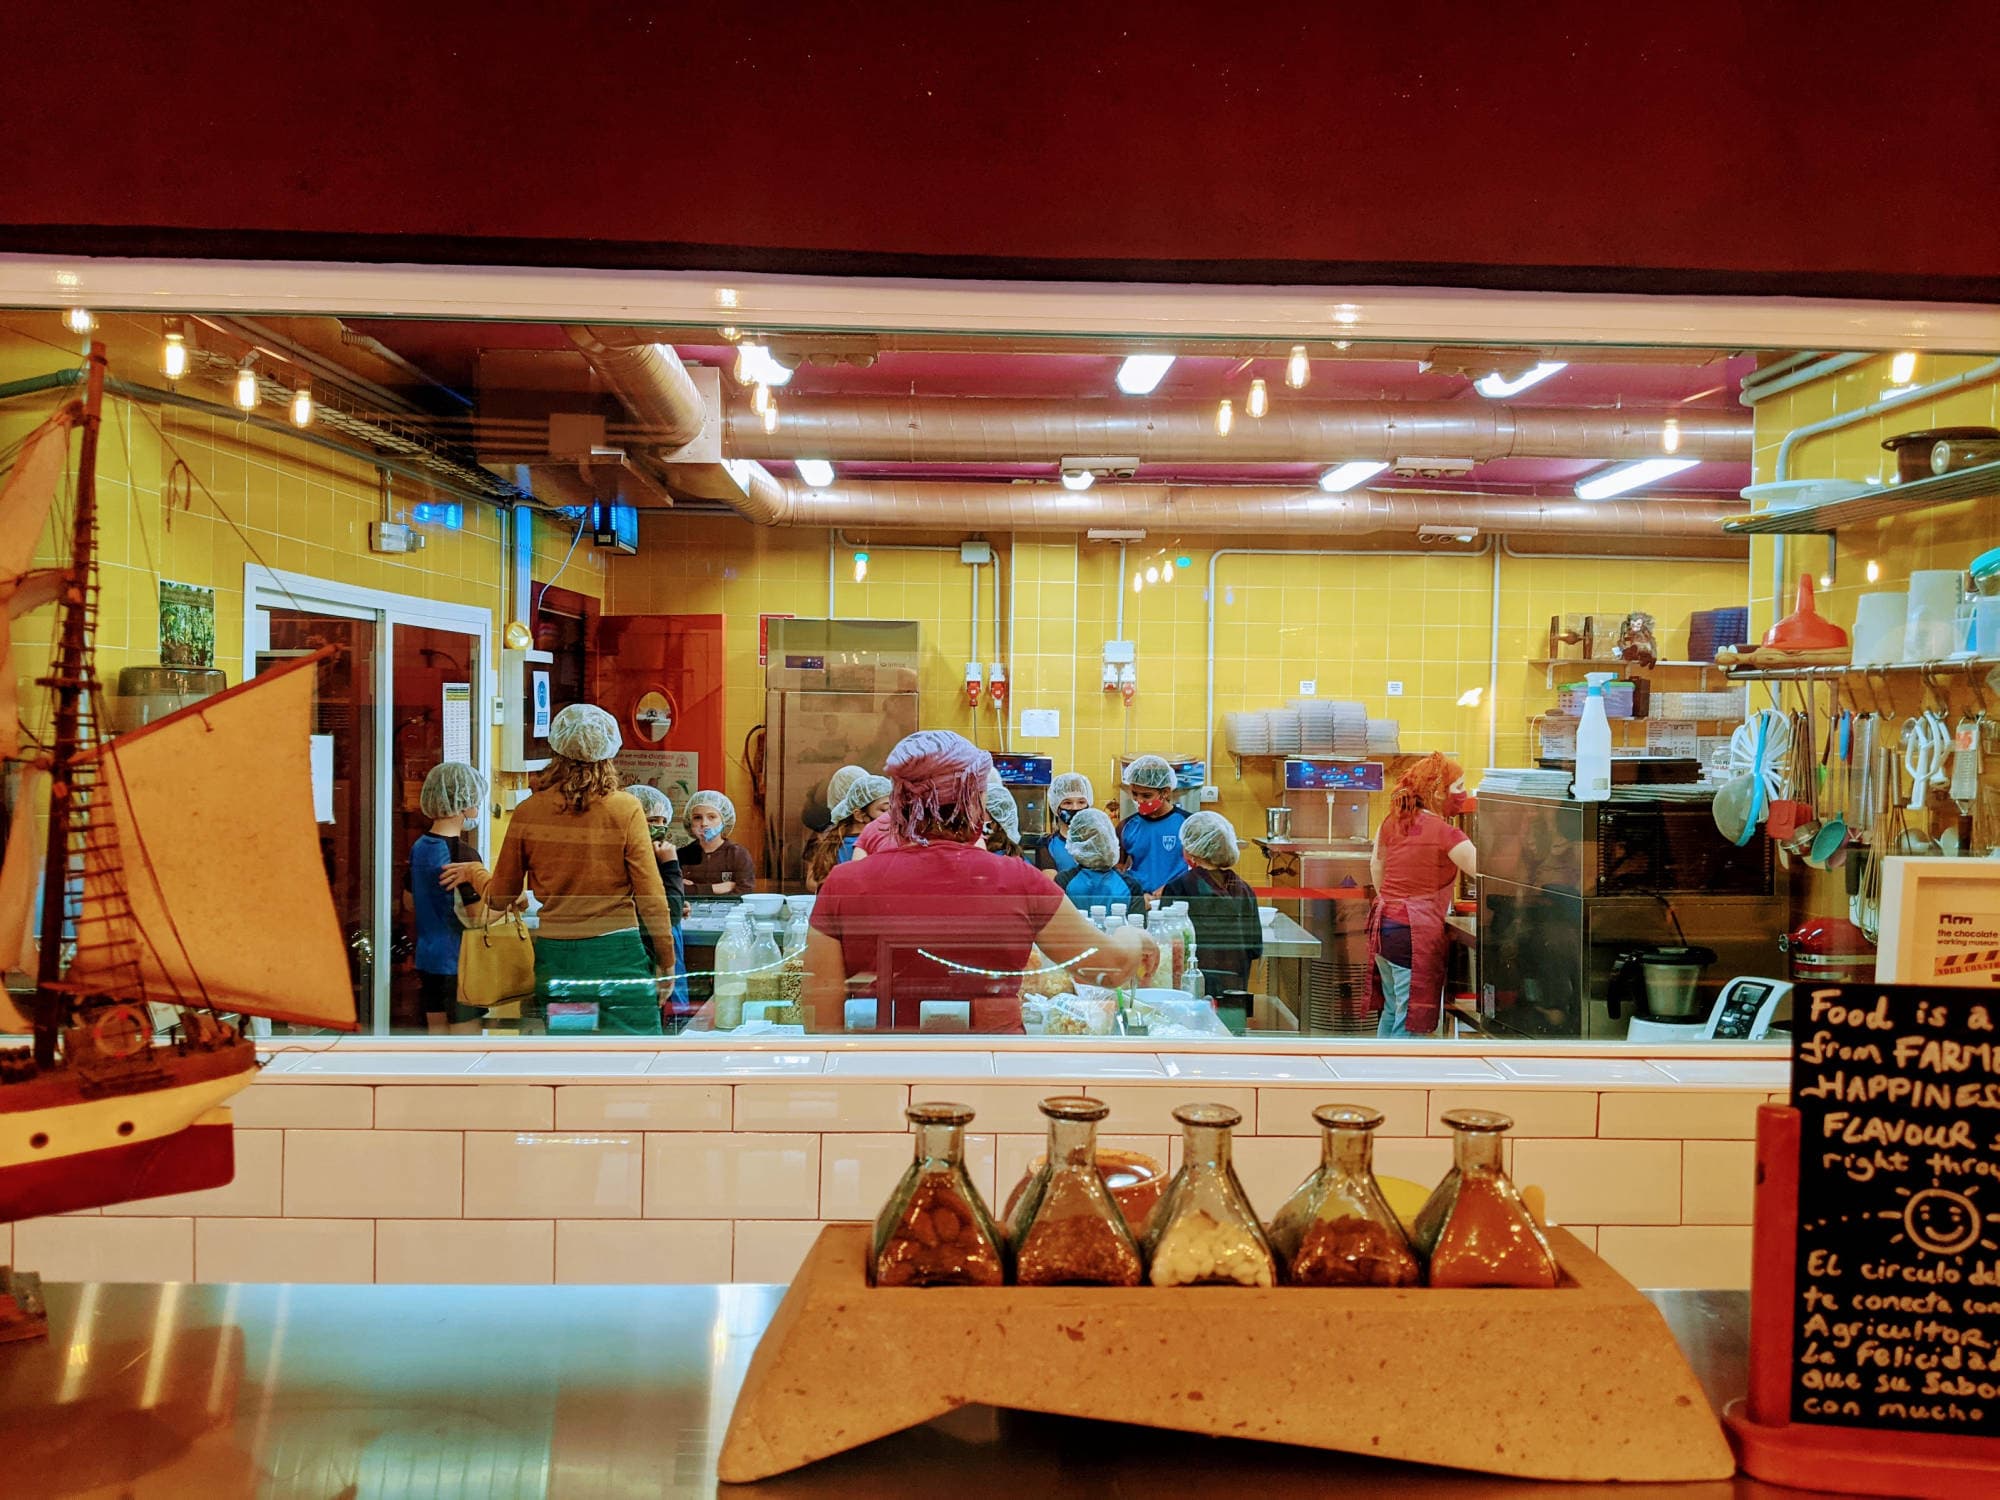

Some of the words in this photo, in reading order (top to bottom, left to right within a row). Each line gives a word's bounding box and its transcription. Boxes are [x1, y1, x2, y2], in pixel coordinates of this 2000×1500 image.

[1937, 929, 1952, 937] the
[1954, 930, 1998, 938] chocolate
[1811, 988, 1894, 1030] Food
[1916, 1001, 1947, 1027] is
[1967, 1005, 1994, 1031] a
[1800, 1030, 1882, 1064] from
[1823, 1111, 1976, 1150] FLAVOUR
[1823, 1149, 1909, 1182] right
[1803, 1285, 1839, 1312] te
[1852, 1291, 1952, 1314] conecta
[1920, 1371, 2000, 1399] Sabo
[1878, 1402, 1984, 1420] mucho
